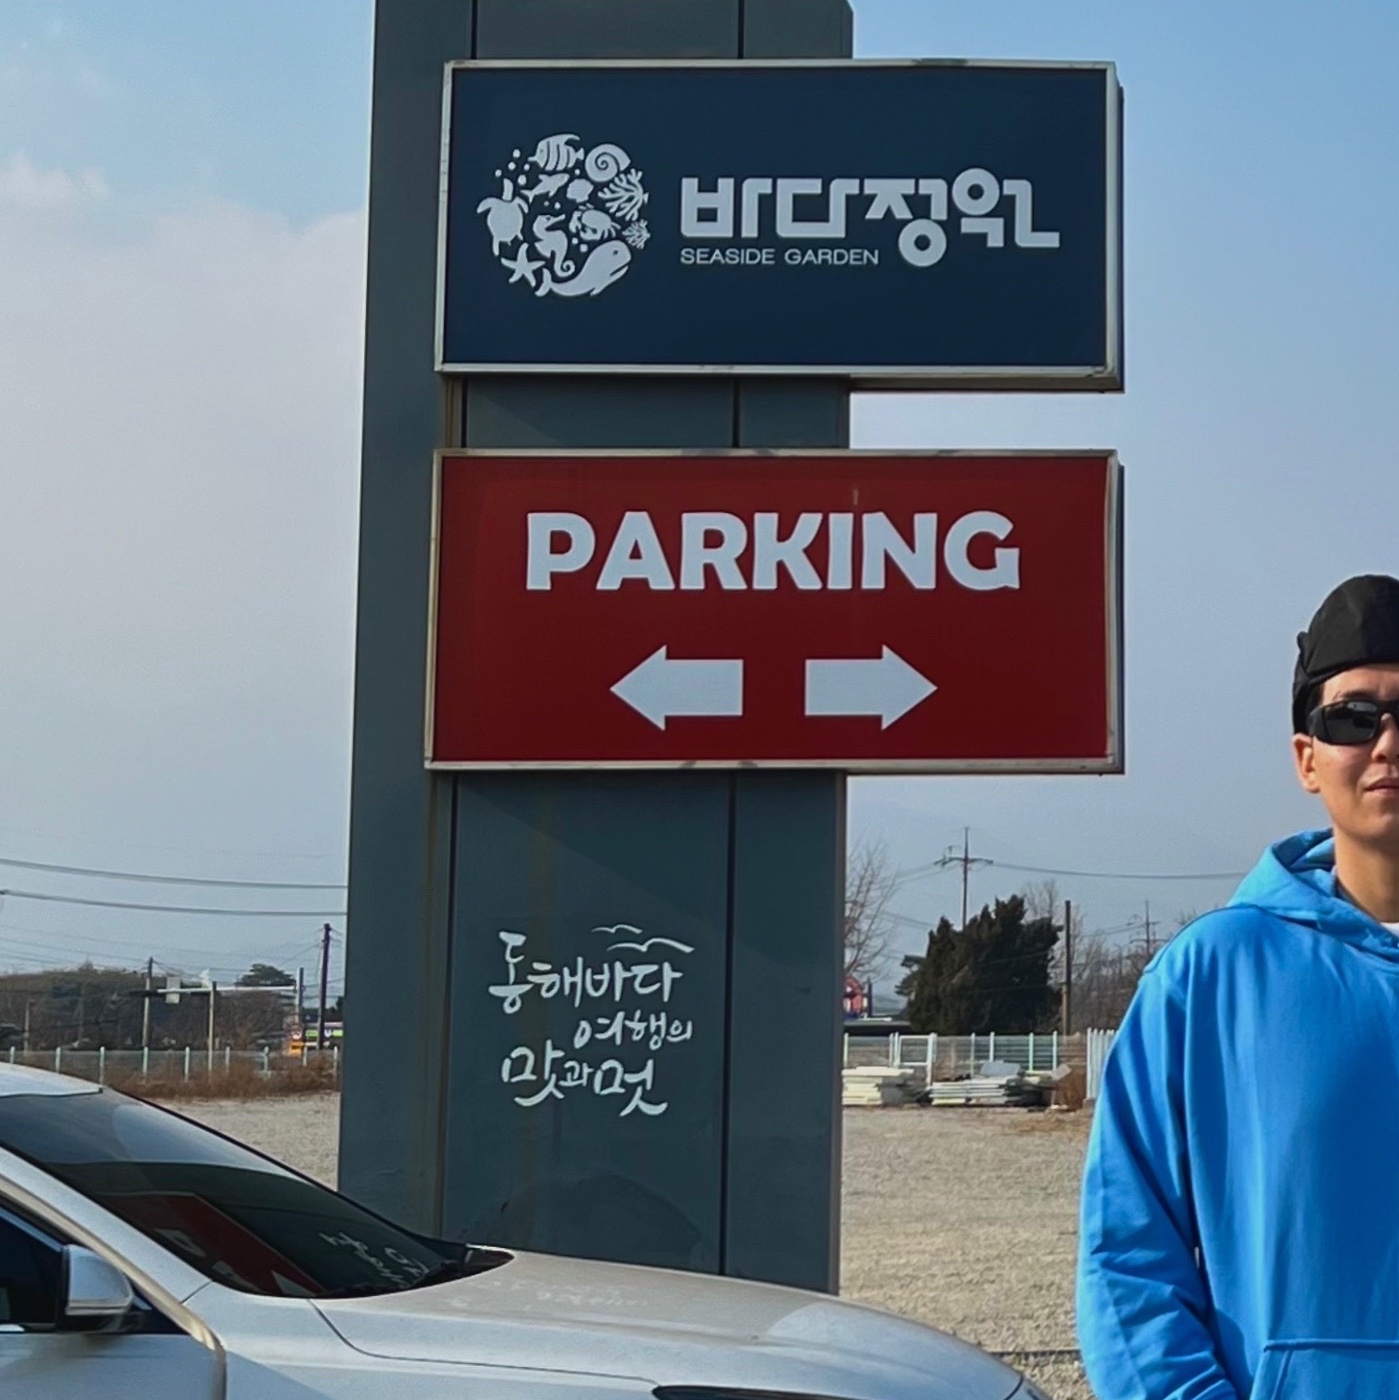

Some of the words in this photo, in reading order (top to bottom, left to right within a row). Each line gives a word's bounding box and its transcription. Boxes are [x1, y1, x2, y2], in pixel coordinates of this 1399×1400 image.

[681, 168, 1059, 267] 바다정원
[680, 248, 775, 265] SEASIDE
[784, 248, 879, 265] GARDEN
[527, 511, 1020, 591] PARKING
[573, 1009, 693, 1050] 여행의
